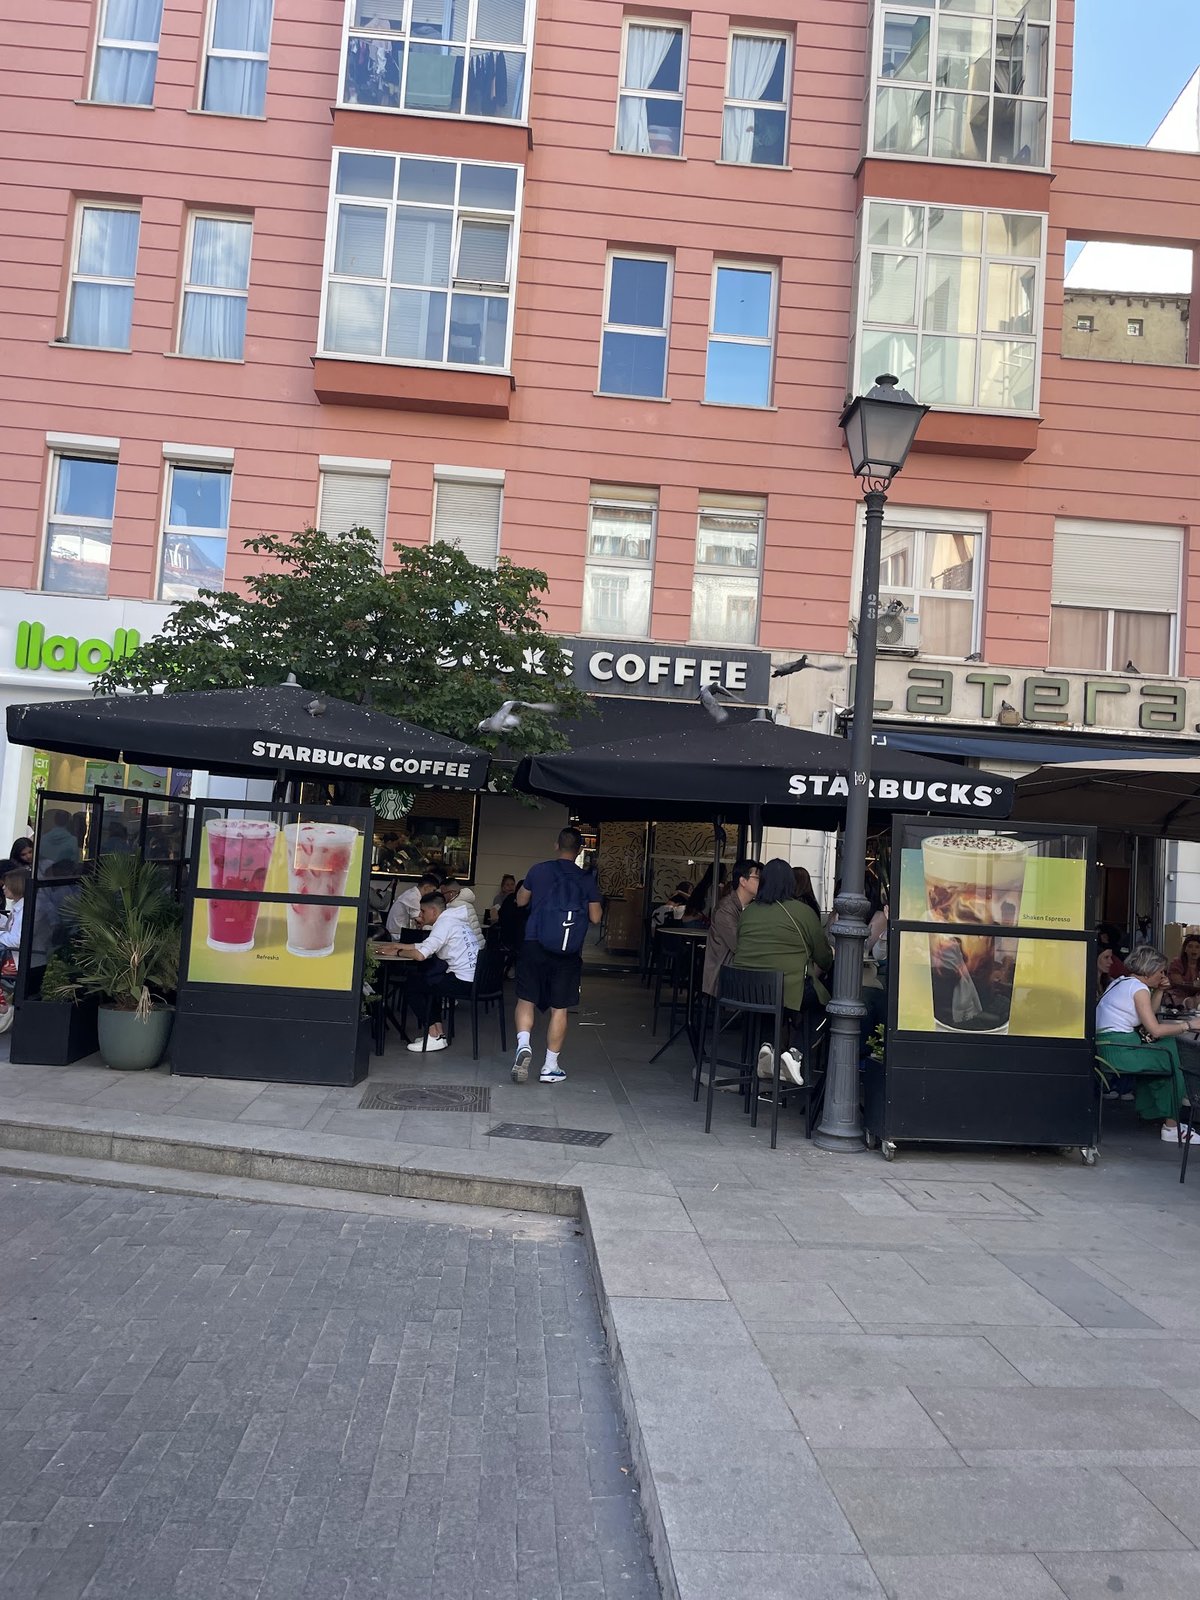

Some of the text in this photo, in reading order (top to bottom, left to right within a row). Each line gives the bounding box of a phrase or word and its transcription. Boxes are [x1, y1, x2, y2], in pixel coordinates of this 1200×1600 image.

[15, 620, 170, 676] llaoll
[588, 651, 748, 690] COFFEE
[251, 740, 471, 779] STARBUCKS COFFEE
[1022, 913, 1071, 923] Shaken Espresso
